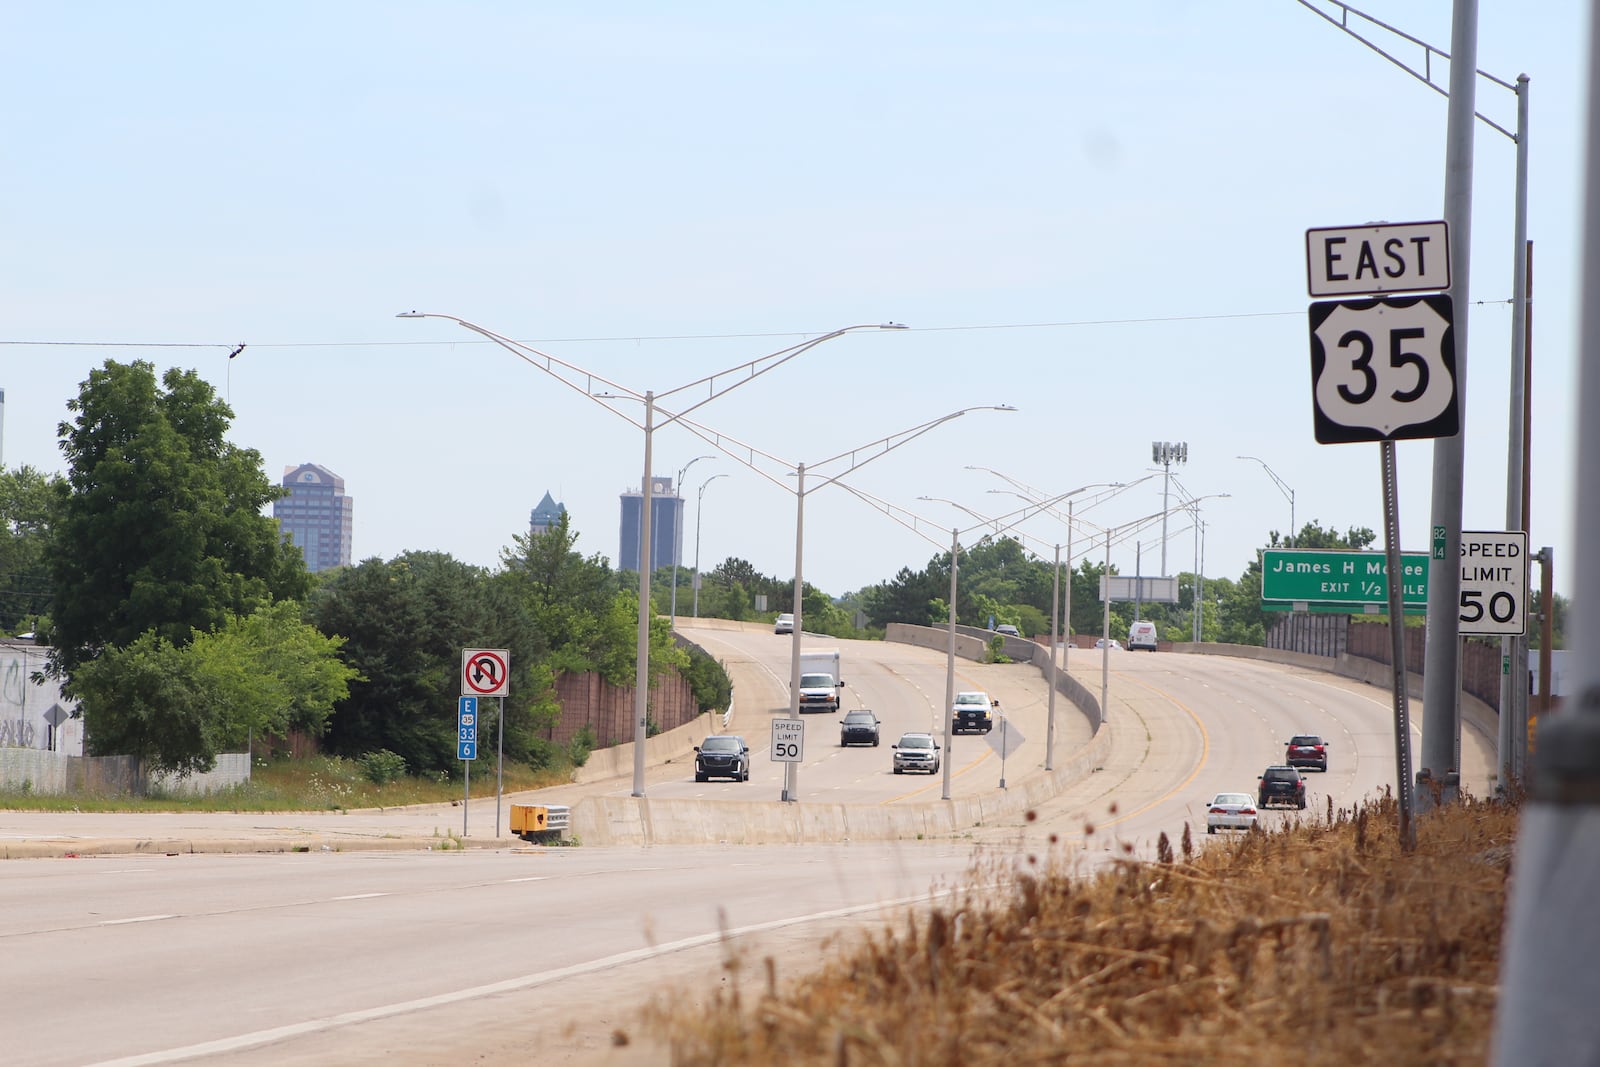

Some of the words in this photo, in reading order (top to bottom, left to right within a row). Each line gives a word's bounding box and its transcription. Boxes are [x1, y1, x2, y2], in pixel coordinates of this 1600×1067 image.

[1325, 236, 1431, 282] EAST
[1336, 327, 1430, 405] 35
[1434, 528, 1446, 540] 82
[1433, 546, 1445, 559] 14
[1273, 560, 1331, 574] James
[1343, 562, 1355, 575] H
[1366, 562, 1423, 576] Mcee
[1462, 567, 1512, 582] LIMIT
[1321, 583, 1350, 593] EXIT
[1361, 581, 1381, 596] 1/2
[1402, 584, 1425, 595] ILE
[1459, 591, 1516, 623] 50
[464, 700, 472, 712] E
[463, 716, 473, 724] 35
[460, 728, 474, 740] 33
[464, 744, 470, 755] 6
[776, 744, 798, 757] 50
